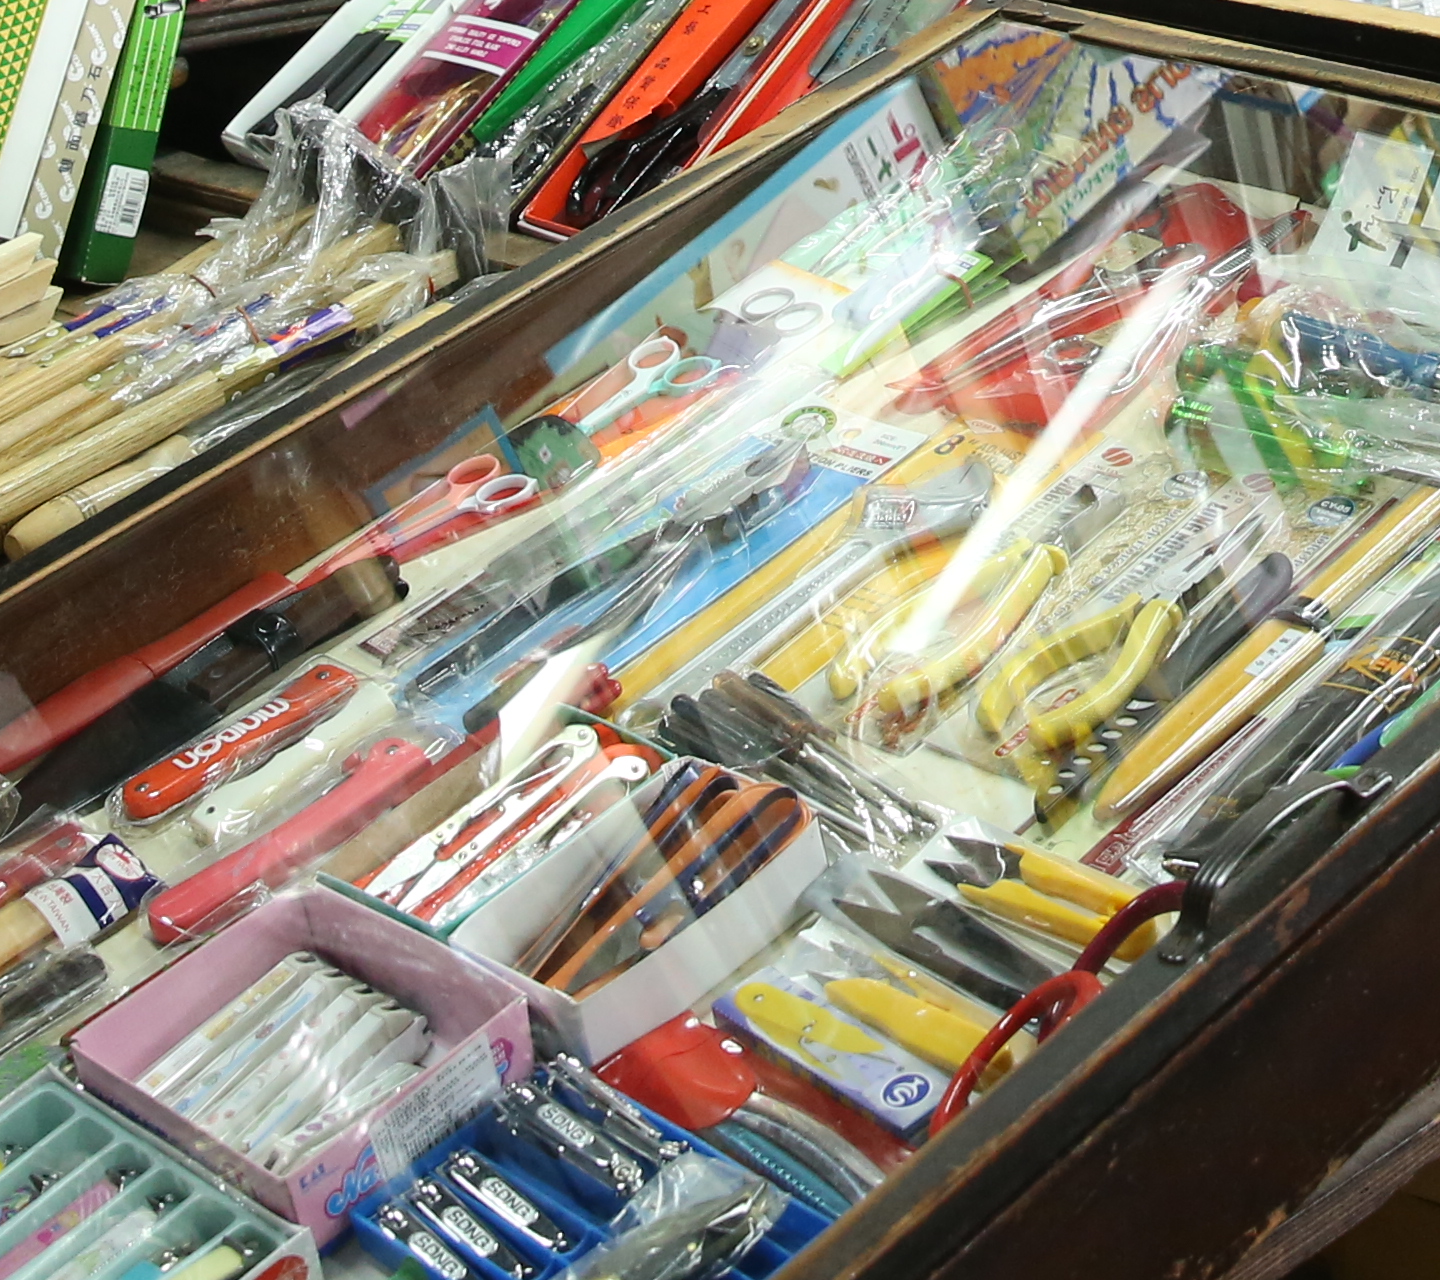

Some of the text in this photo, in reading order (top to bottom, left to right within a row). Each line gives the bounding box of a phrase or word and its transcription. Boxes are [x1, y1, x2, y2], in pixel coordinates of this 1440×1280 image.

[541, 1104, 589, 1144] SONG
[487, 1180, 531, 1223] SONG
[448, 1209, 491, 1253] SONG
[413, 1234, 459, 1277] SONG
